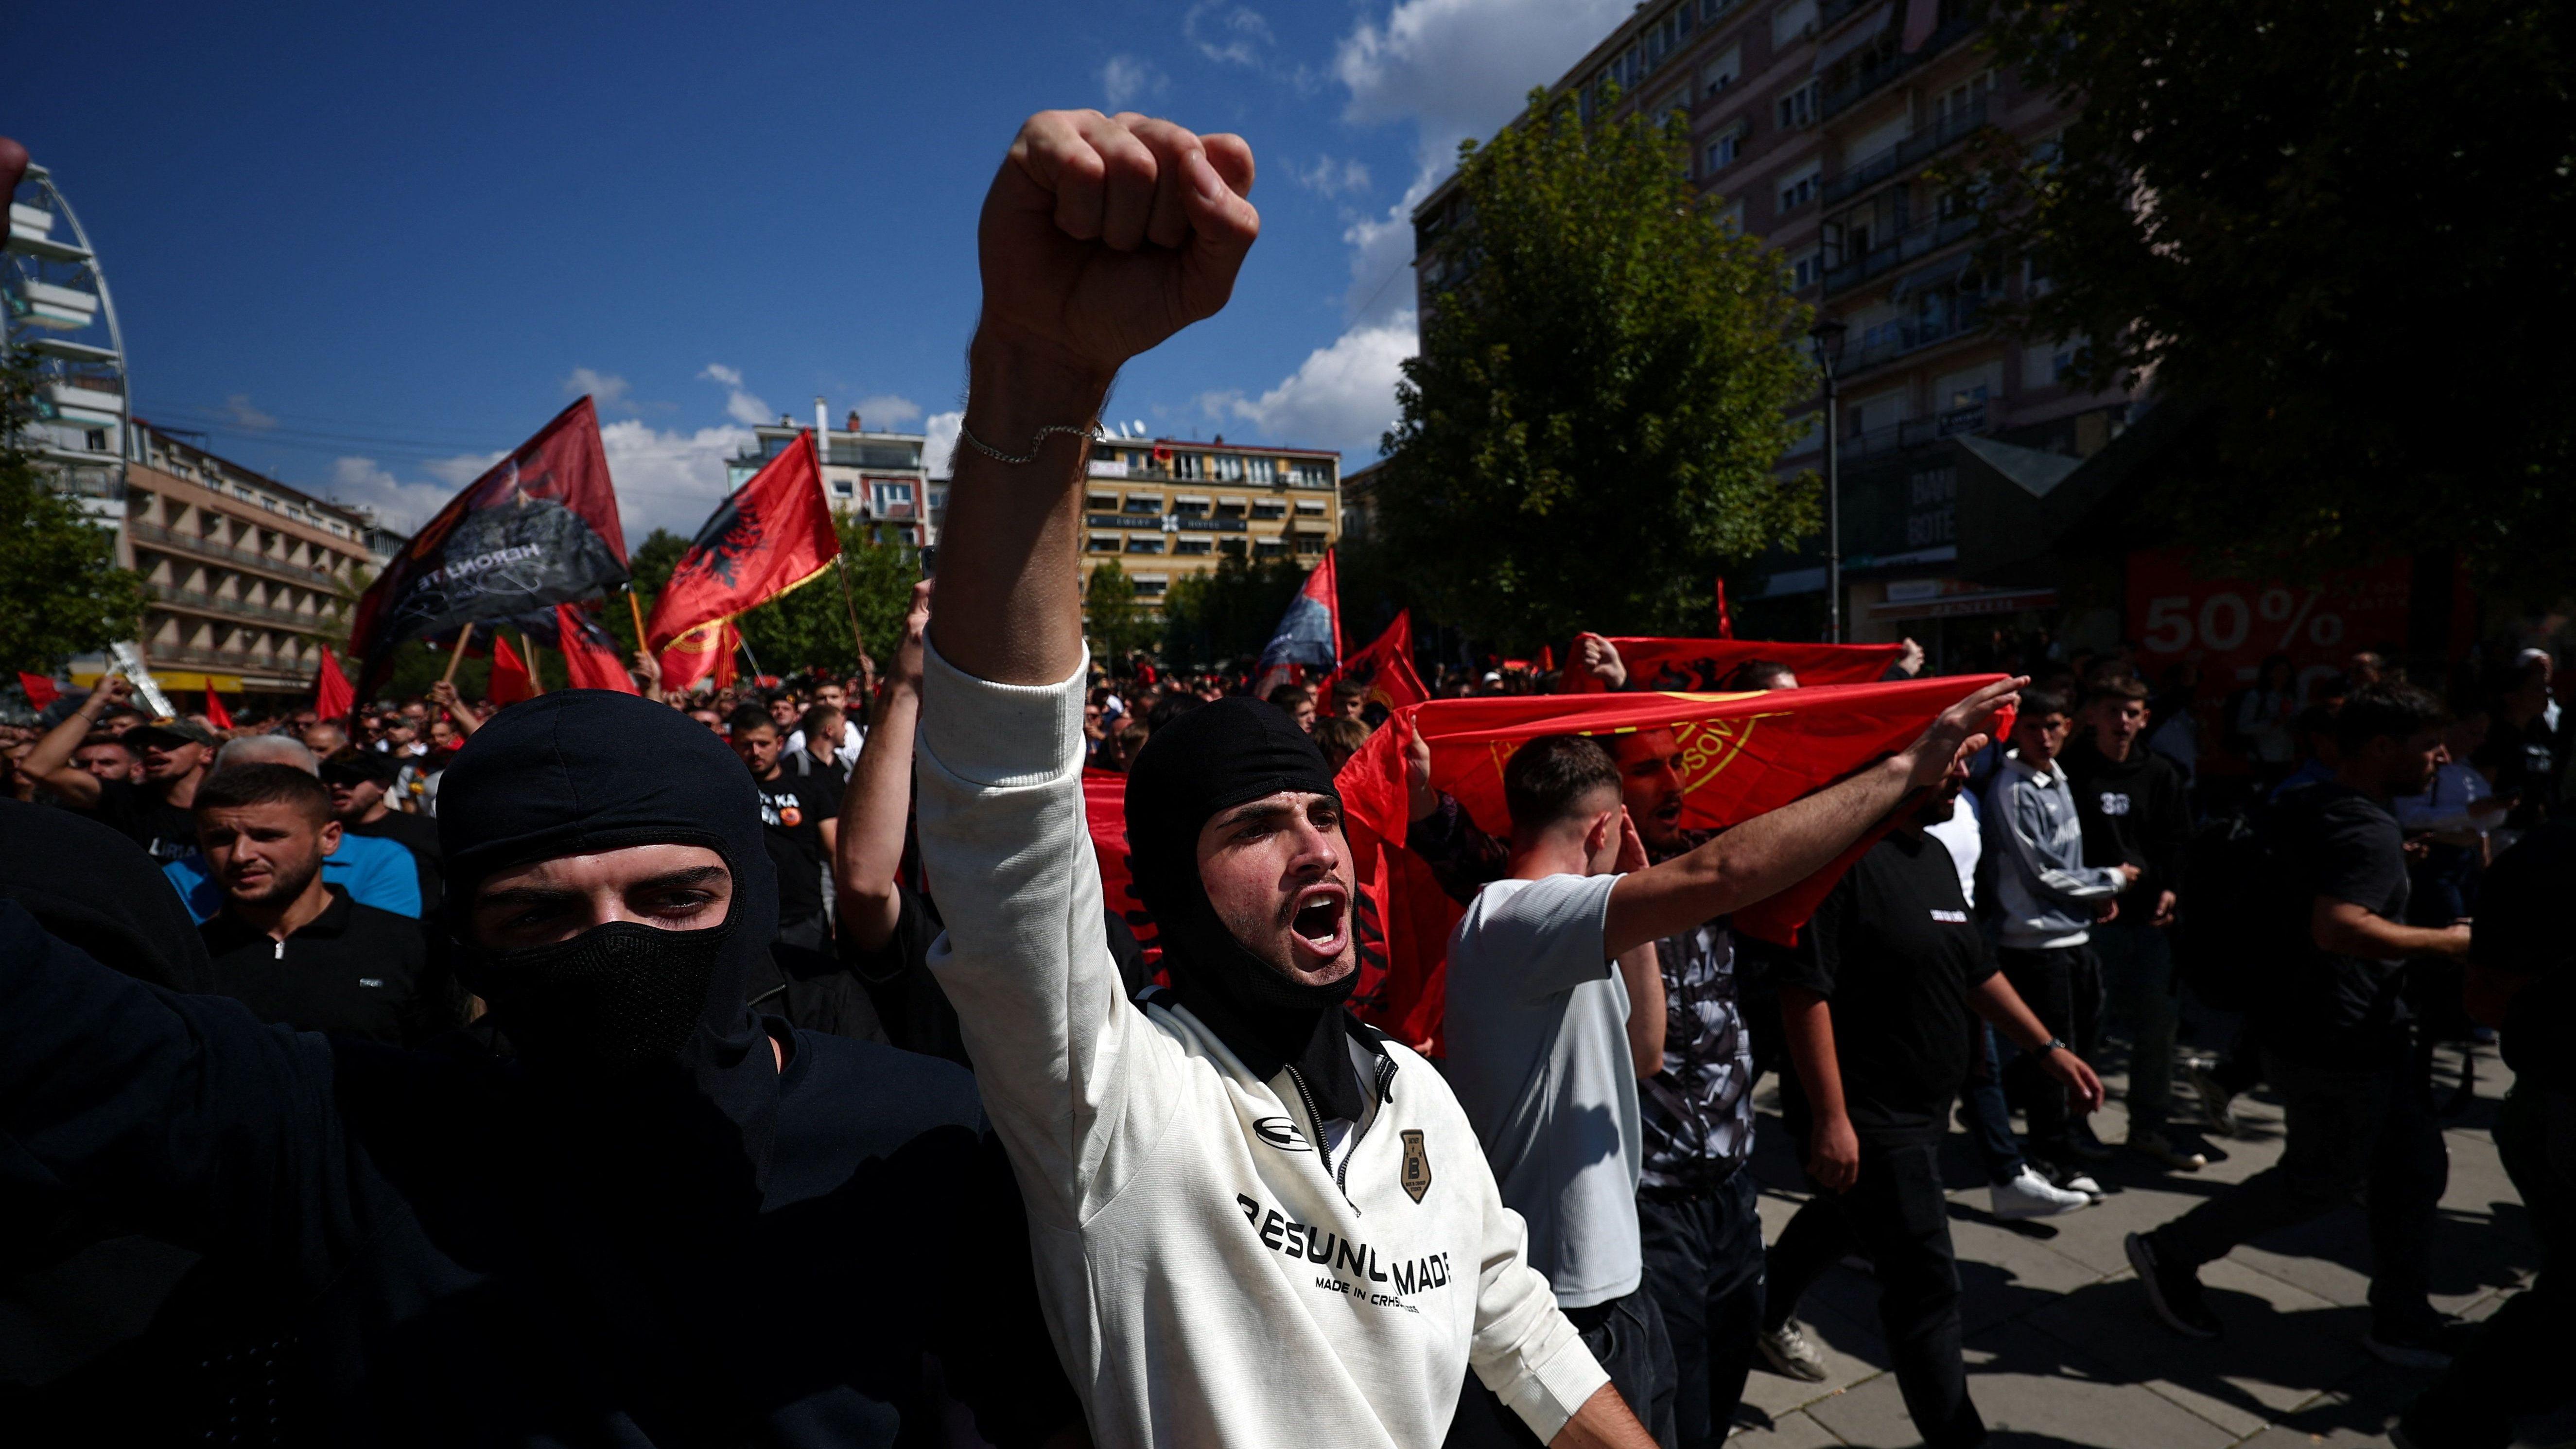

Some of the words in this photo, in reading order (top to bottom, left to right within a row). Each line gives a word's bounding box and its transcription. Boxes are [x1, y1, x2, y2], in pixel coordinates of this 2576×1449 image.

[2143, 586, 2343, 653] 50%
[1408, 1157, 1419, 1179] B
[1316, 1276, 1350, 1294] MADE
[1354, 1287, 1366, 1300] IN
